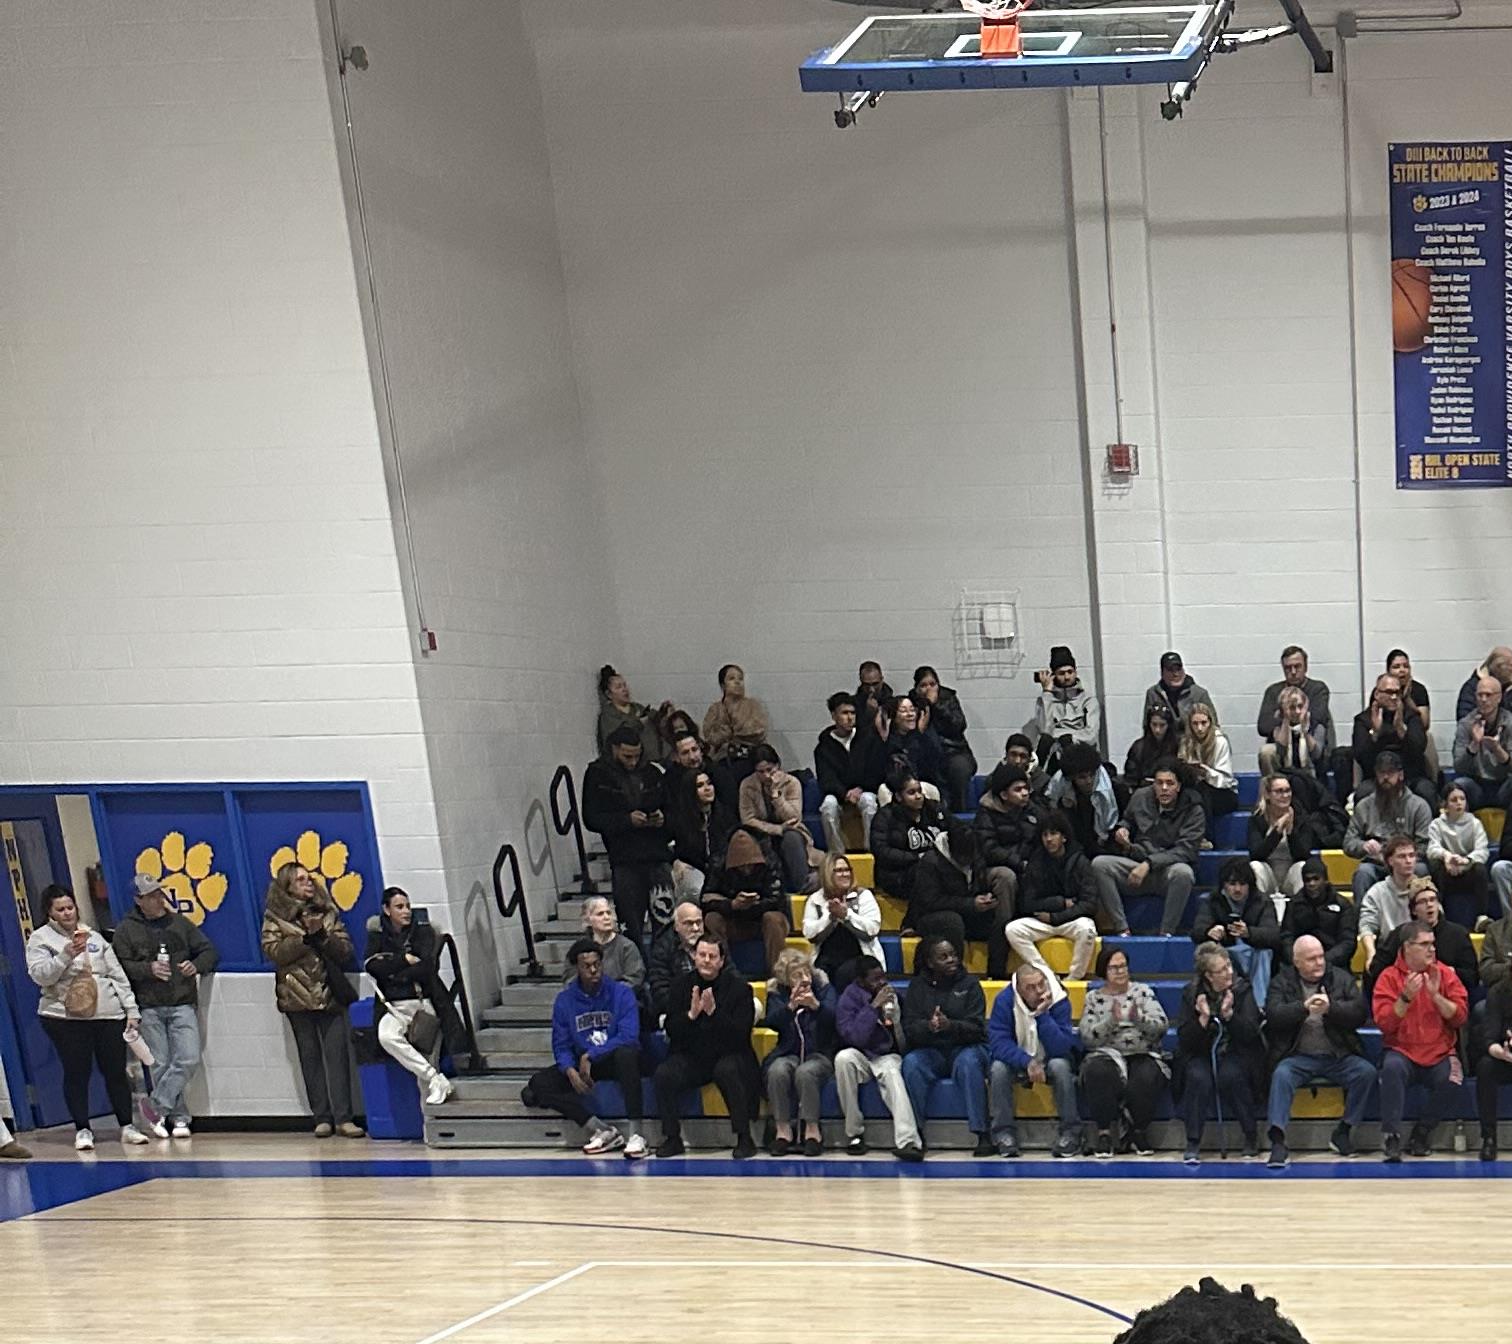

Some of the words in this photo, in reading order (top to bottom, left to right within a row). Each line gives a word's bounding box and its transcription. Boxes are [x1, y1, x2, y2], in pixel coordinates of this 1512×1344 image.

[1424, 147, 1448, 160] BACK
[1450, 146, 1462, 160] TO
[1464, 146, 1488, 160] BACK
[1393, 164, 1429, 182] STATE
[1431, 162, 1498, 182] CHAMPIONS
[1472, 454, 1500, 465] STATE
